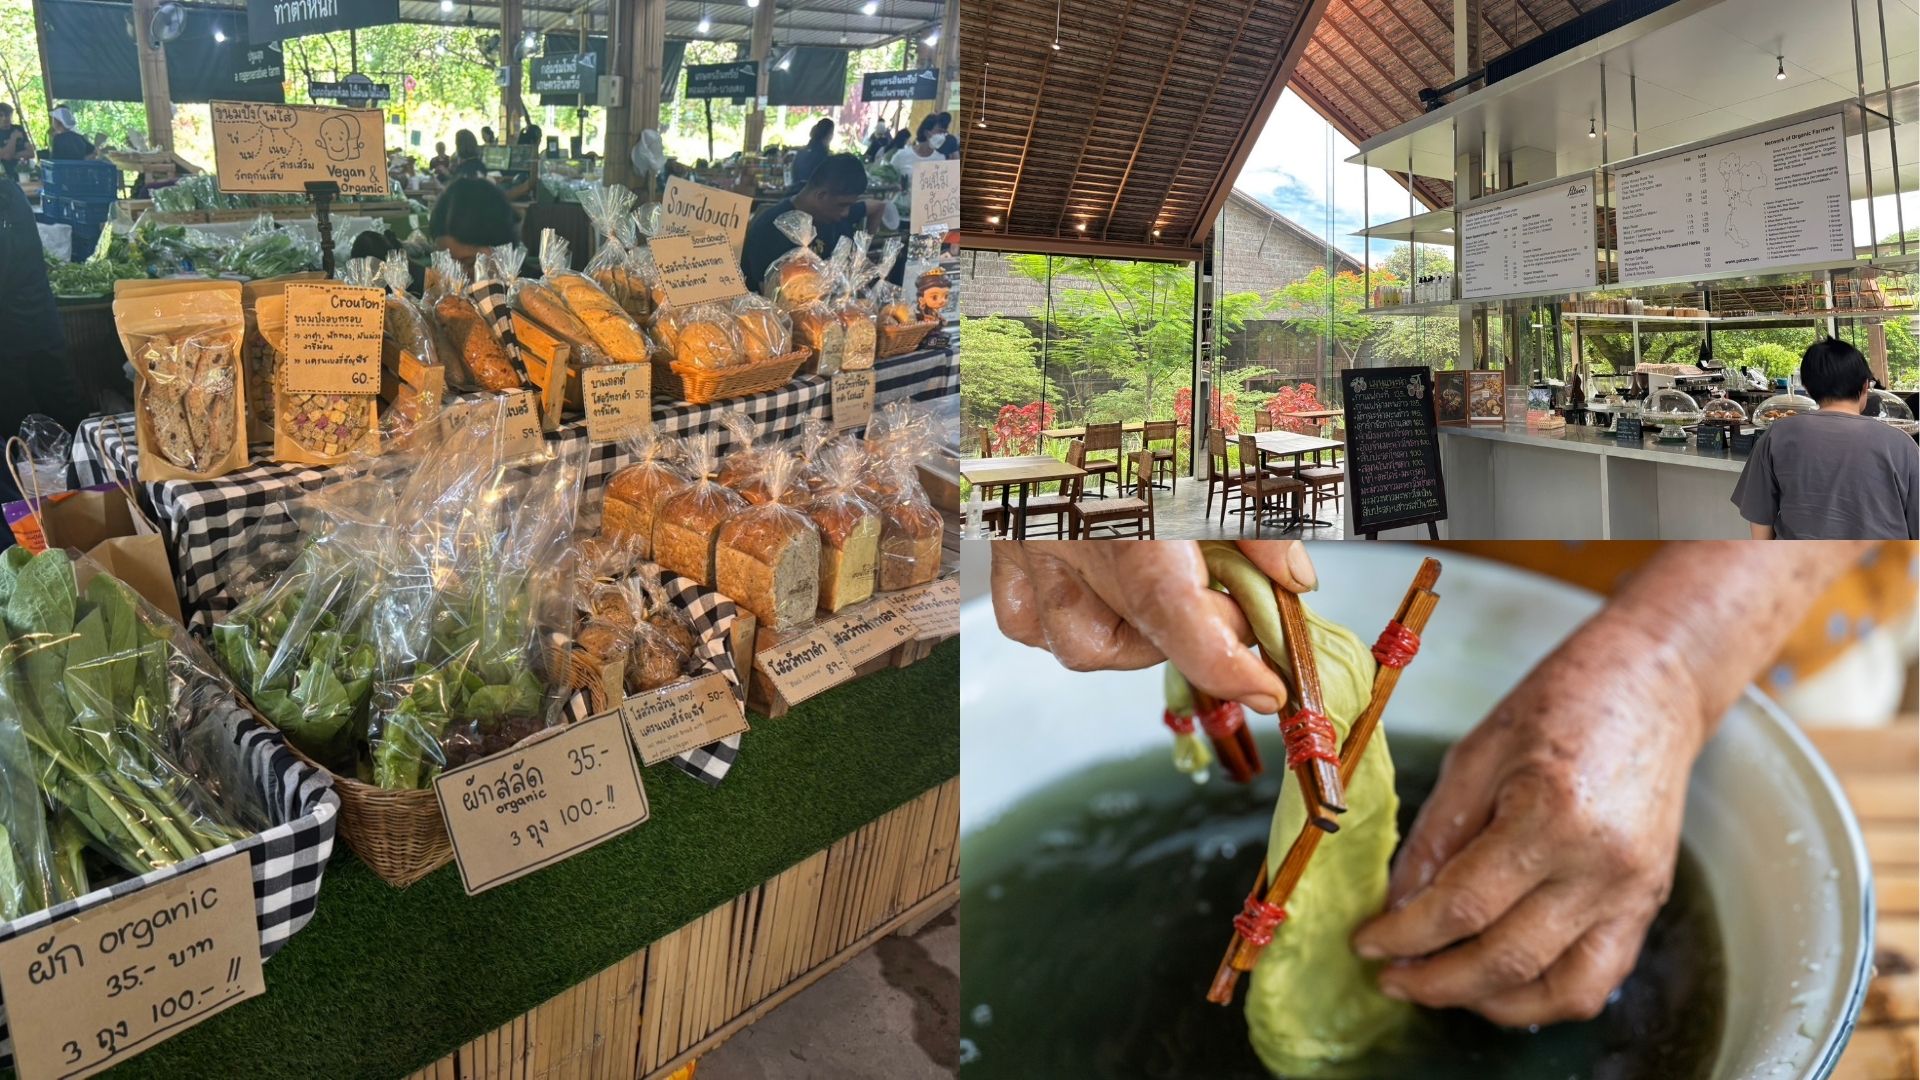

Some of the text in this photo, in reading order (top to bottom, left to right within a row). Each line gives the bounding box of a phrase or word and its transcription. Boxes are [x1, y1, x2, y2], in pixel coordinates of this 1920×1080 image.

[1764, 138, 1785, 146] Network
[1791, 131, 1811, 139] Organic
[1812, 126, 1835, 135] Farmers
[326, 165, 366, 182] Vegan
[340, 182, 384, 196] Organic
[667, 186, 740, 229] Sourdough
[924, 186, 960, 221] น้ำสลั
[691, 233, 726, 246] Sourdough
[331, 294, 380, 309] Crouton
[351, 372, 375, 385] 60.-
[522, 427, 539, 439] 59.-
[833, 609, 898, 648] ฮลวีทฟักทอง
[893, 622, 913, 637] 89.-
[767, 640, 828, 678] โฮลวีทงาดำ
[825, 660, 845, 676] 89.-
[707, 690, 725, 703] 50.-
[462, 744, 609, 811] ผักสลัด 35.-
[496, 787, 547, 814] organic
[510, 831, 521, 846] 3
[526, 819, 549, 848] ถุง
[28, 887, 219, 985] ผัก organic
[106, 936, 214, 998] 35.- บาท
[62, 1040, 82, 1065] 3
[96, 1020, 129, 1056] ถุง
